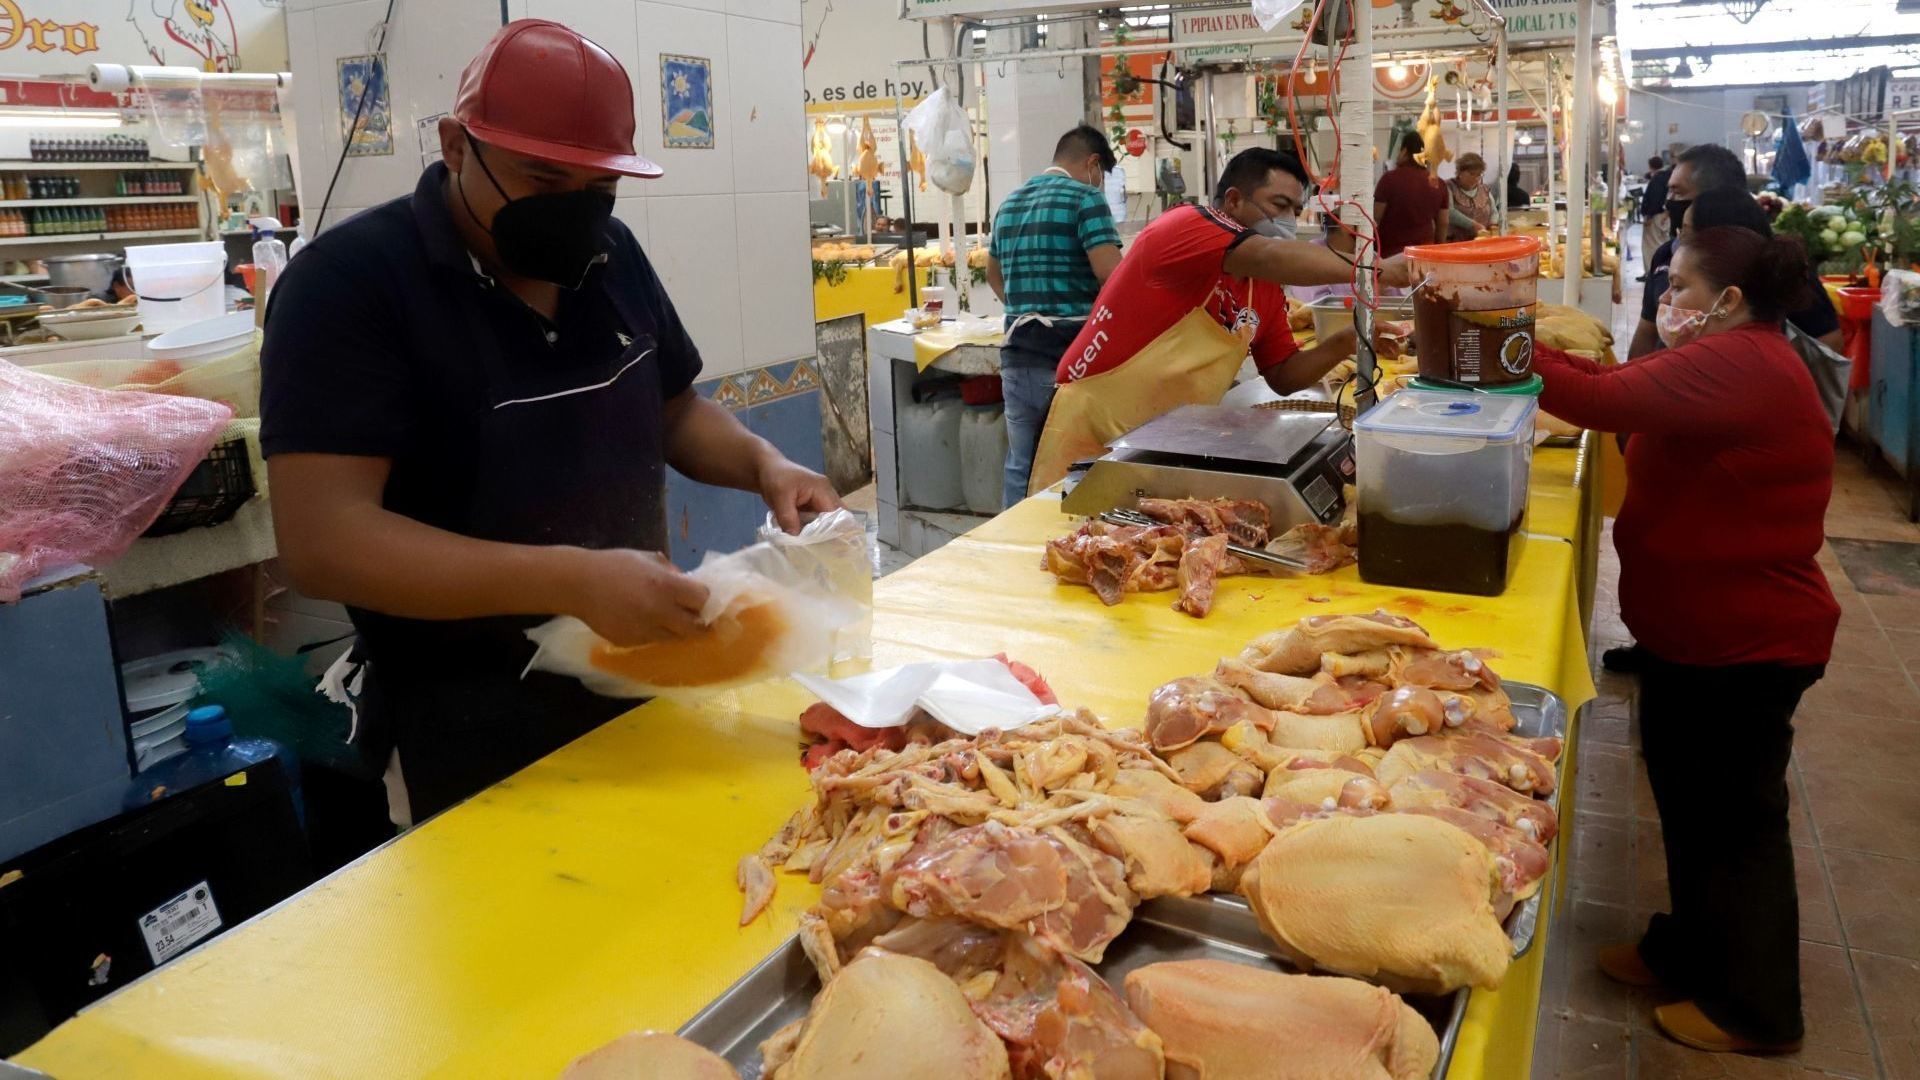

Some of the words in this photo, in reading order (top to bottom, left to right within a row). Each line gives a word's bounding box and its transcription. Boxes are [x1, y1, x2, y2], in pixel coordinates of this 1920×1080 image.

[1182, 18, 1188, 34] Y
[1190, 15, 1223, 34] PIPIAN
[1225, 14, 1241, 31] EN
[1242, 13, 1260, 30] PAS
[1508, 15, 1546, 33] LOCAL
[1549, 13, 1556, 30] 7
[1559, 12, 1567, 29] Y
[823, 86, 846, 101] es
[853, 81, 877, 100] de
[885, 79, 928, 100] hoy.
[155, 934, 175, 953] 23.54
